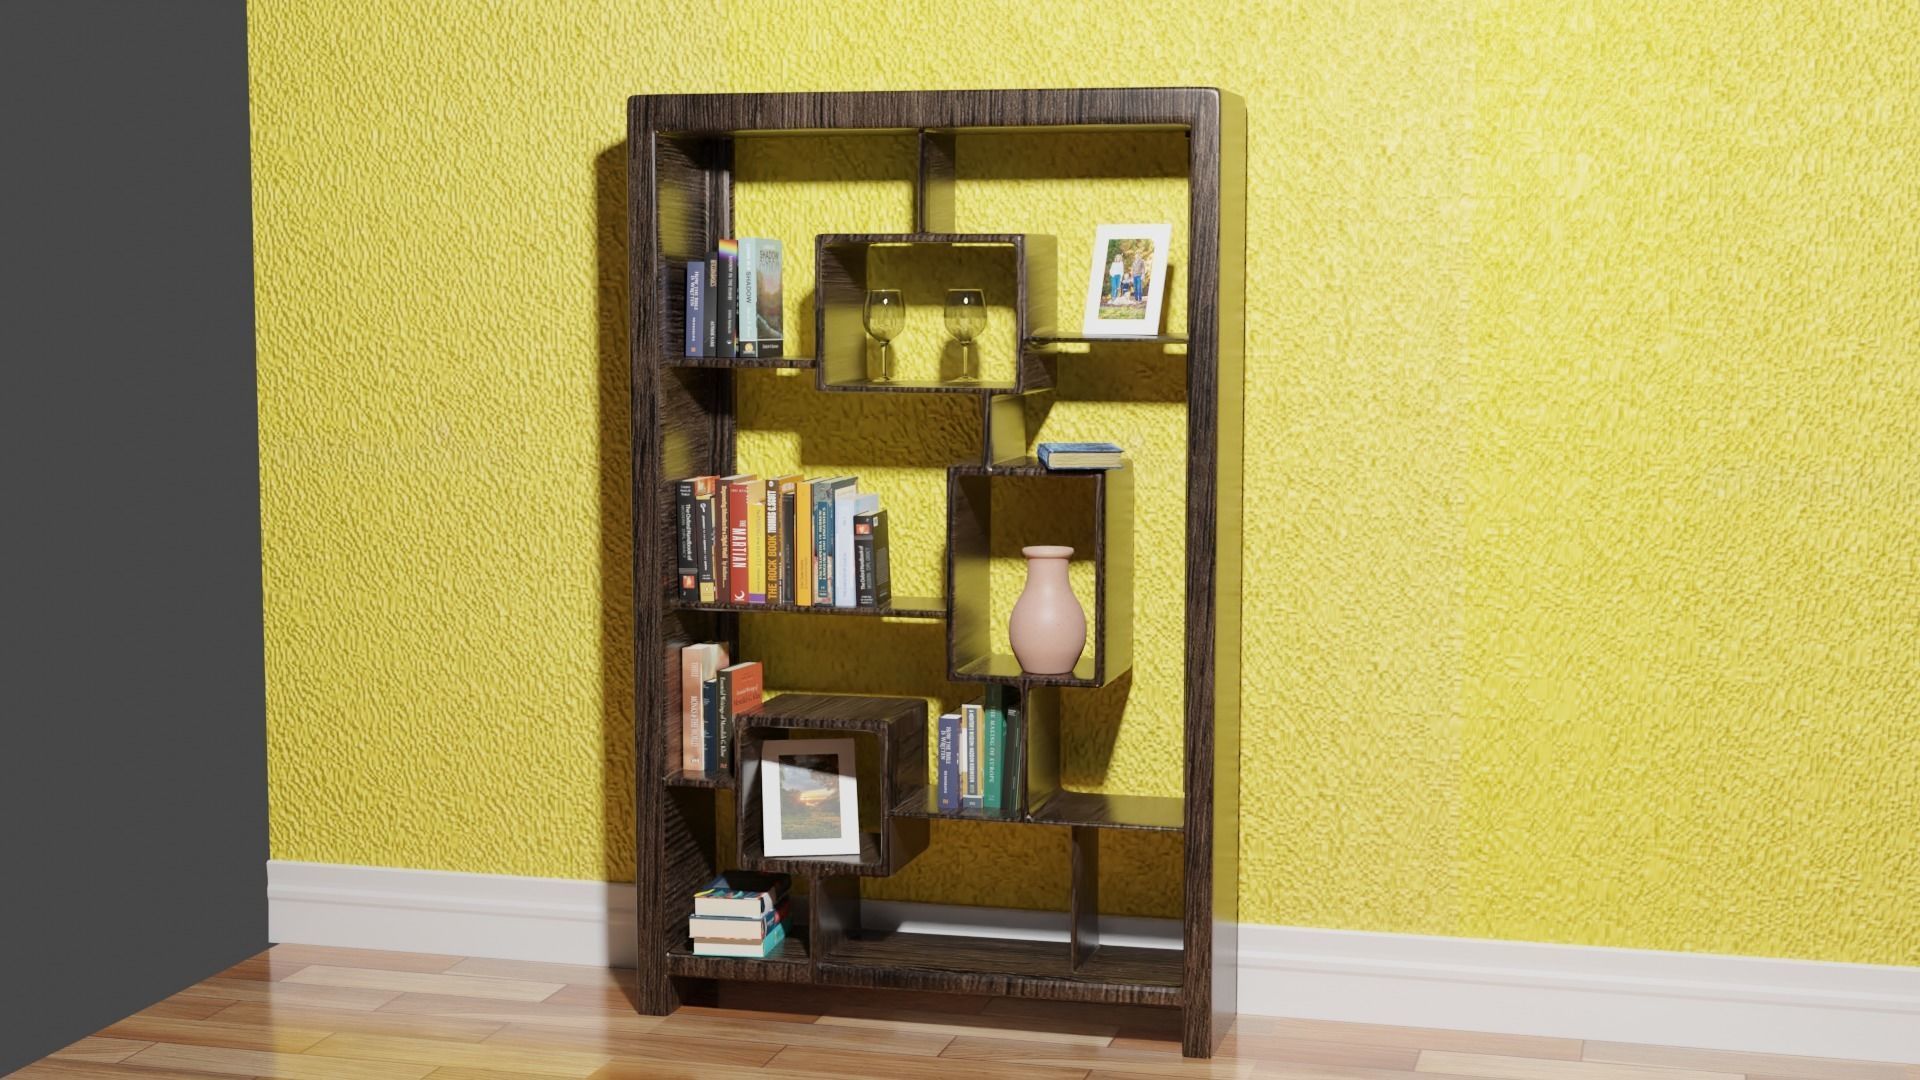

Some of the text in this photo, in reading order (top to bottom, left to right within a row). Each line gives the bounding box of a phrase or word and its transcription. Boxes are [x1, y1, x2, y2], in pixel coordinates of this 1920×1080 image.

[767, 512, 777, 533] THOMAS
[732, 527, 747, 568] MARTIAN
[767, 535, 777, 557] BOOK
[767, 559, 777, 581] ROCK
[767, 584, 777, 599] THE
[719, 696, 727, 714] Writings
[989, 747, 996, 756] OF
